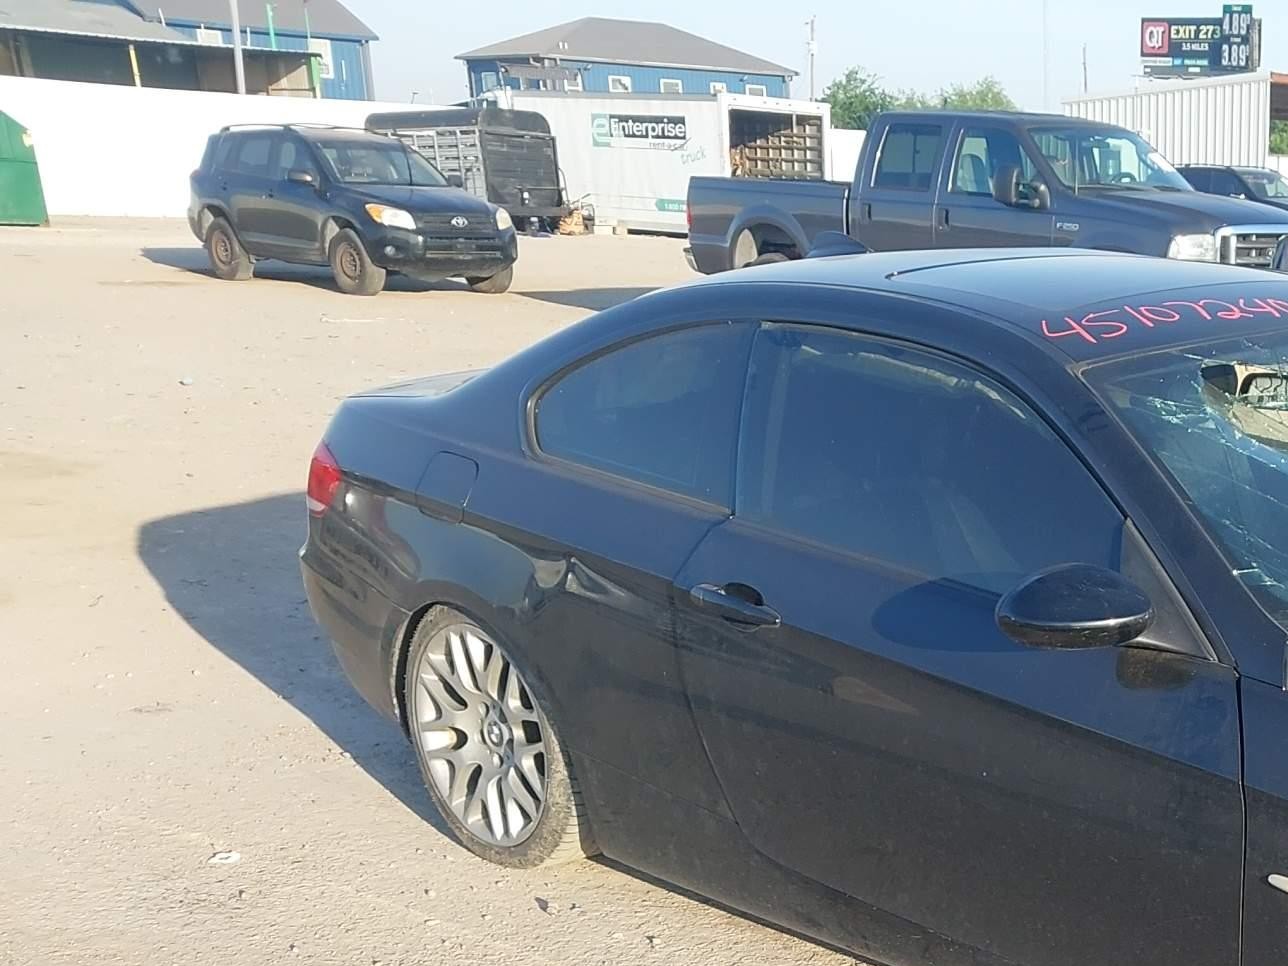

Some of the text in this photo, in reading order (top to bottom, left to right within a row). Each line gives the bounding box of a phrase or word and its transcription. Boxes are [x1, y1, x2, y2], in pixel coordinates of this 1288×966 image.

[1145, 25, 1164, 49] QT
[1170, 24, 1221, 39] EXIT 273
[1191, 42, 1209, 51] MILES
[610, 118, 686, 140] Enterprise
